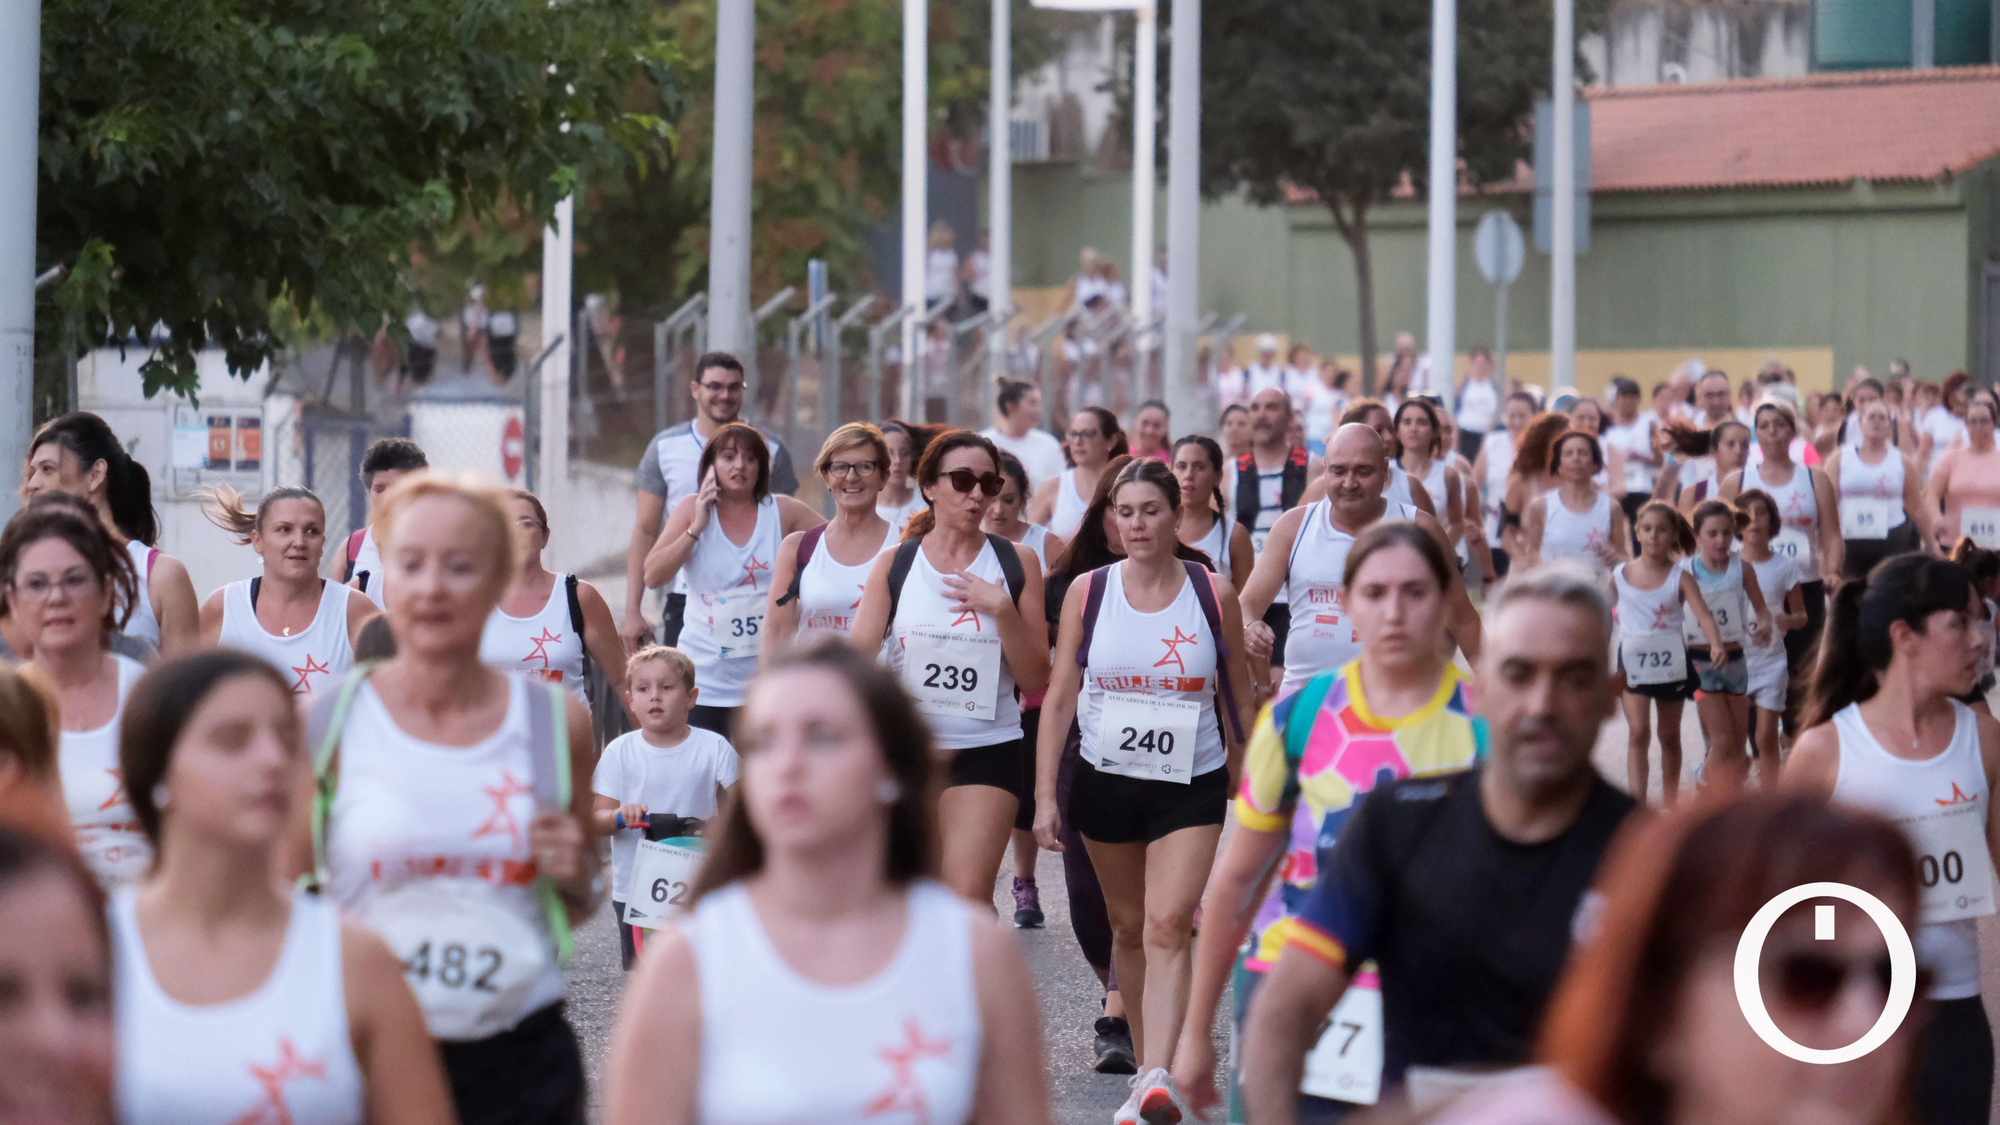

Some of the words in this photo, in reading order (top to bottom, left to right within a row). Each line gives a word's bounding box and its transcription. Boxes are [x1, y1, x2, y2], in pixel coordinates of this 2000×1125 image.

[1769, 542, 1798, 558] 70
[731, 615, 764, 637] 35
[923, 633, 951, 642] CARRERA
[1636, 651, 1672, 668] 732
[923, 663, 978, 692] 239
[1121, 696, 1149, 705] CARRERA
[1167, 702, 1186, 710] MUJER
[1119, 727, 1174, 755] 240
[1918, 851, 1963, 888] 00
[651, 877, 690, 907] 62
[401, 941, 503, 993] 482
